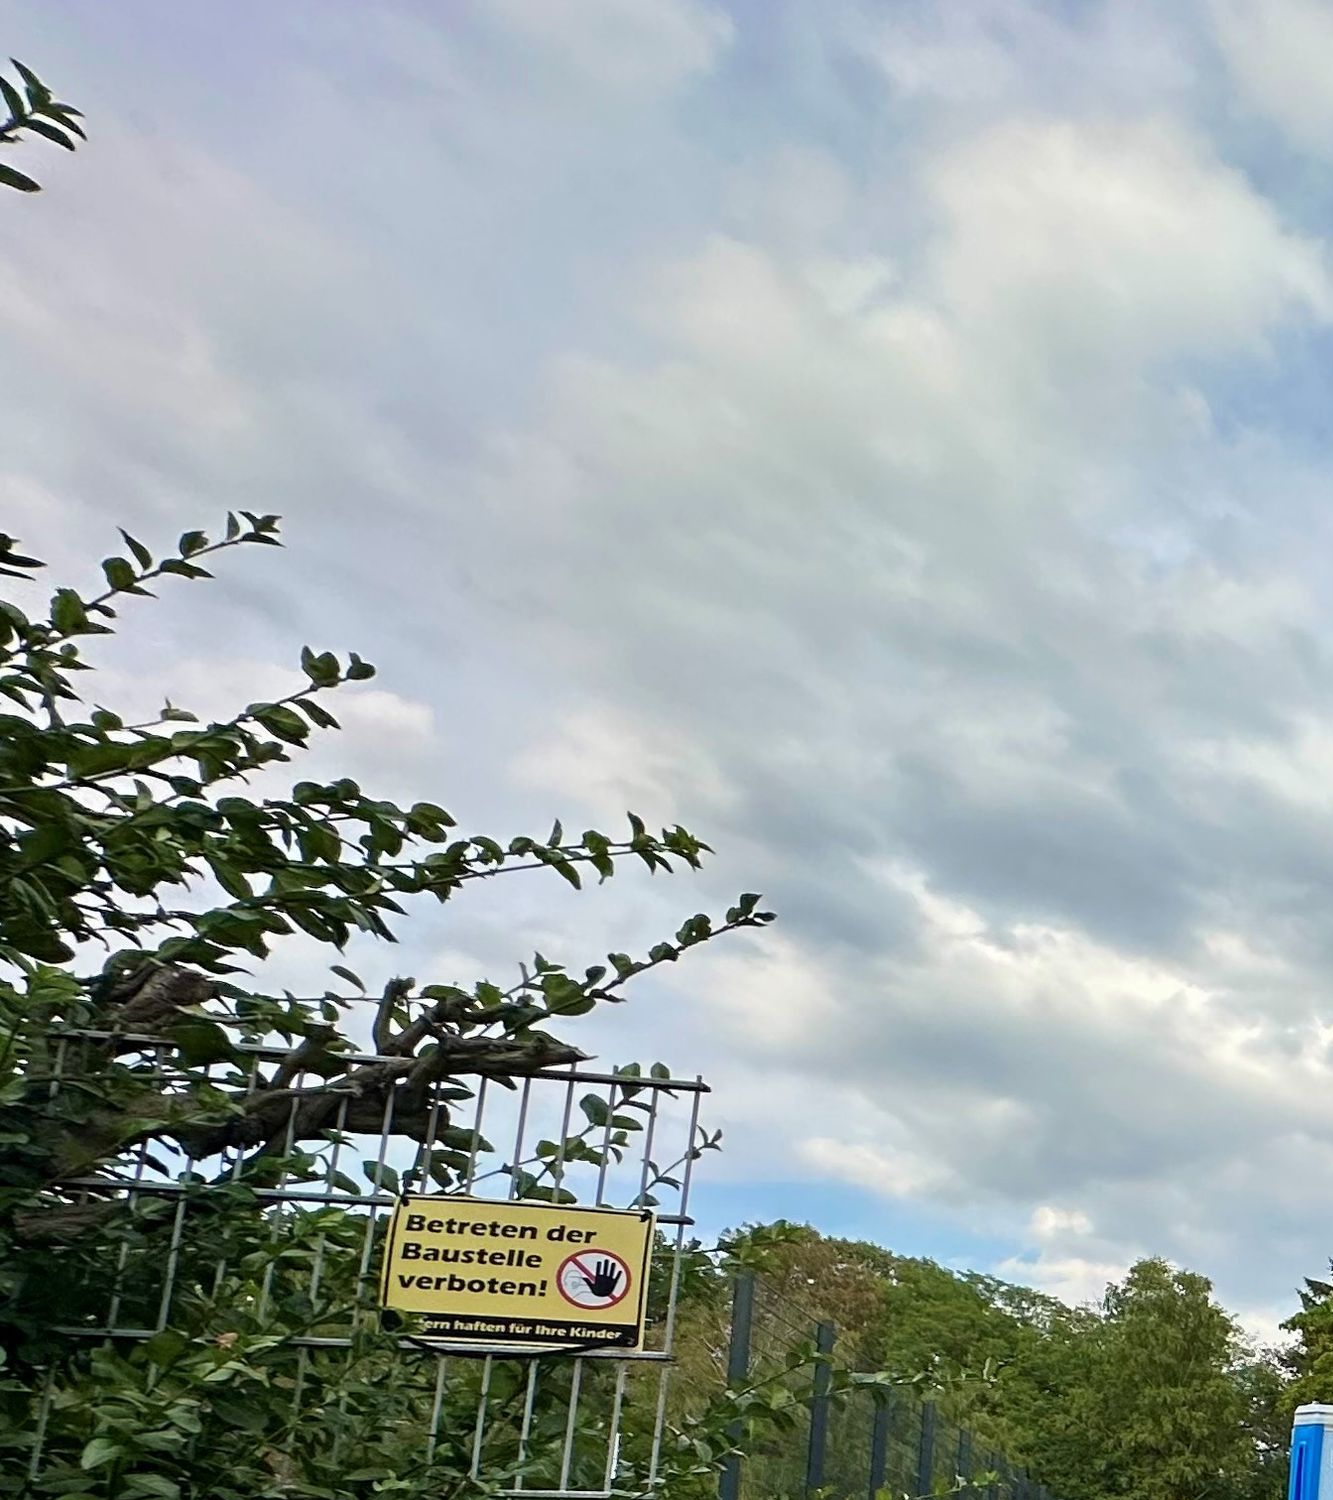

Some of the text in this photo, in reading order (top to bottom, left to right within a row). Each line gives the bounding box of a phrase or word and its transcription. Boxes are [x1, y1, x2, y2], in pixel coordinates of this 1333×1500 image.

[405, 1214, 597, 1244] Betreten der
[401, 1242, 543, 1269] Baustelle
[398, 1273, 548, 1298] verboten!
[453, 1319, 507, 1333] haften
[509, 1323, 532, 1335] für
[535, 1326, 567, 1338] Ihre
[569, 1327, 623, 1340] Kinder
